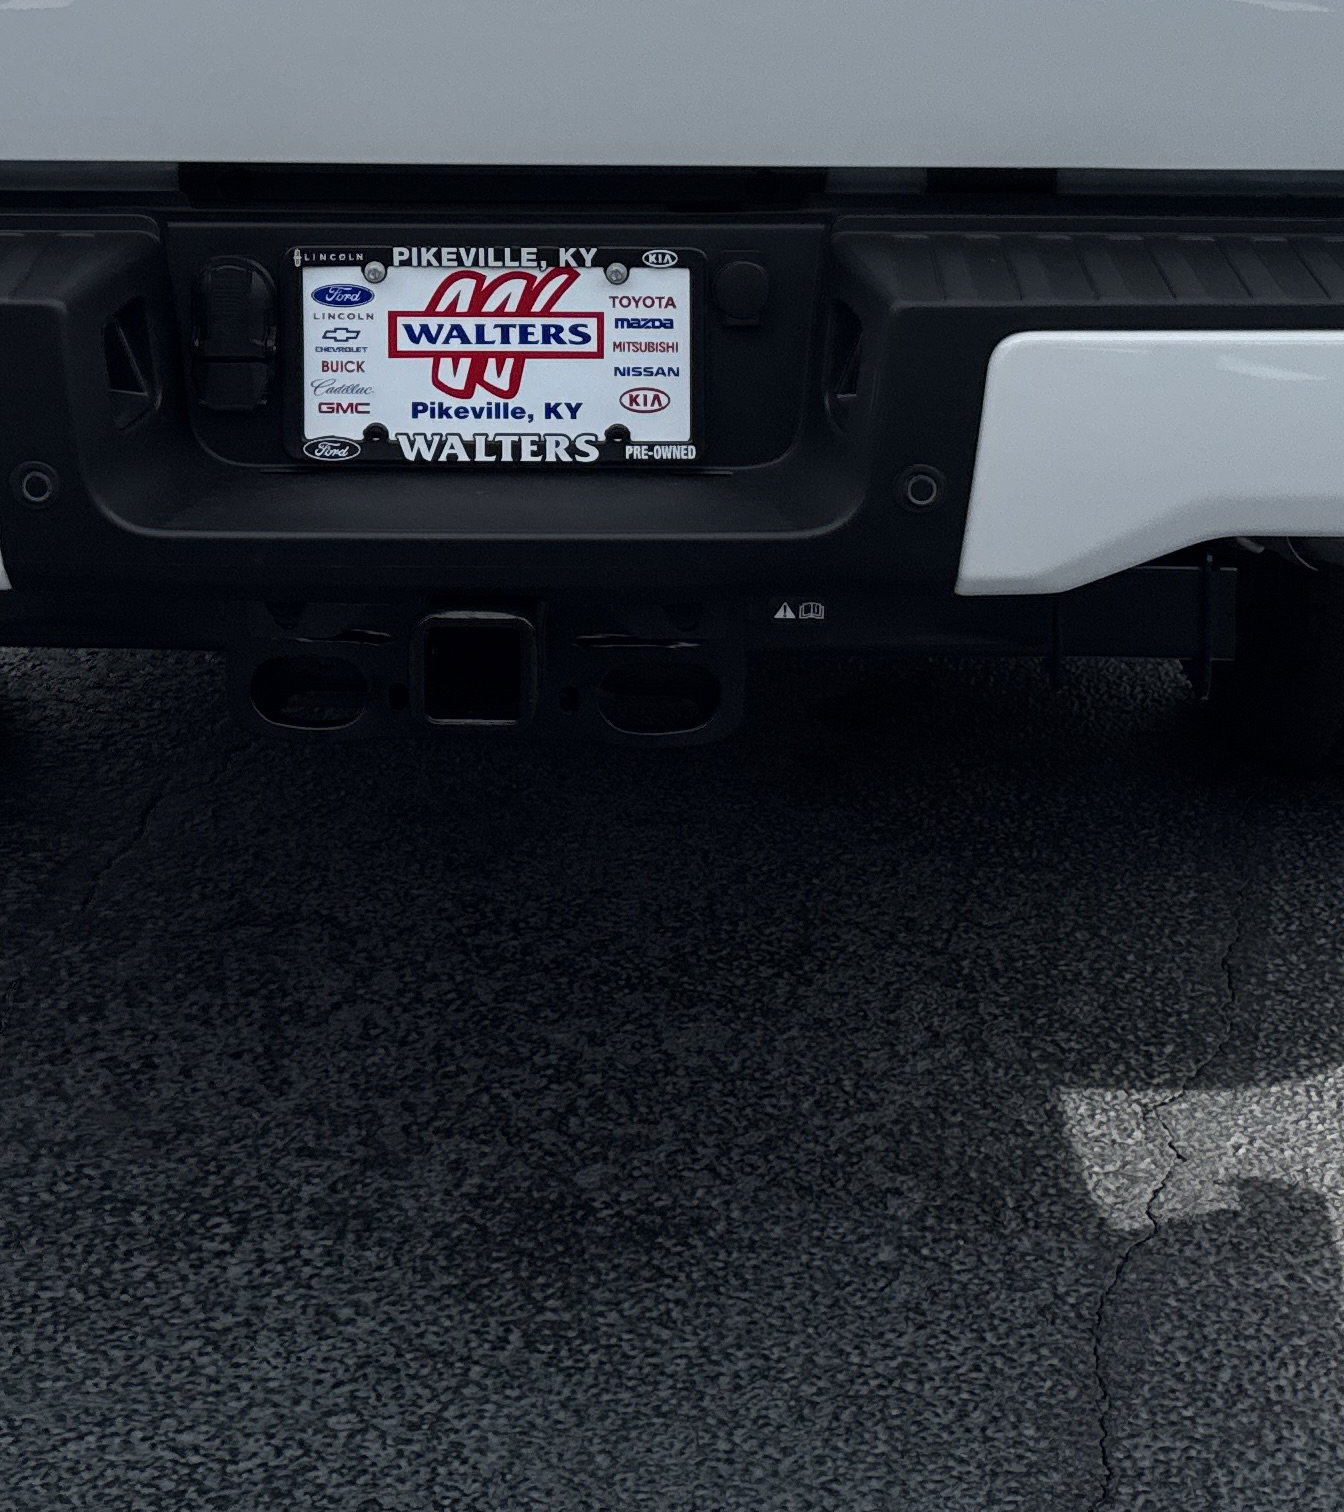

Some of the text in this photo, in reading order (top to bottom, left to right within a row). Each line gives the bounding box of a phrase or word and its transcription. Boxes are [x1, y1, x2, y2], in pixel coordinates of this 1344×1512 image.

[303, 252, 364, 262] LINCOLN
[392, 246, 598, 272] PIKEVILLE, KY
[608, 295, 678, 310] TOYOTA
[312, 312, 375, 321] LINCOLN
[401, 323, 593, 346] WALTERS
[314, 346, 369, 354] CHEVROLET
[612, 341, 679, 354] MITSUBISHI
[321, 360, 366, 373] BUICK
[613, 365, 681, 378] NISSAN
[309, 377, 375, 397] Cadillac
[317, 402, 371, 415] GMC
[410, 401, 584, 424] Pikeville, KY
[394, 433, 601, 464] WALTERS
[624, 444, 697, 460] PRE-OWNED
